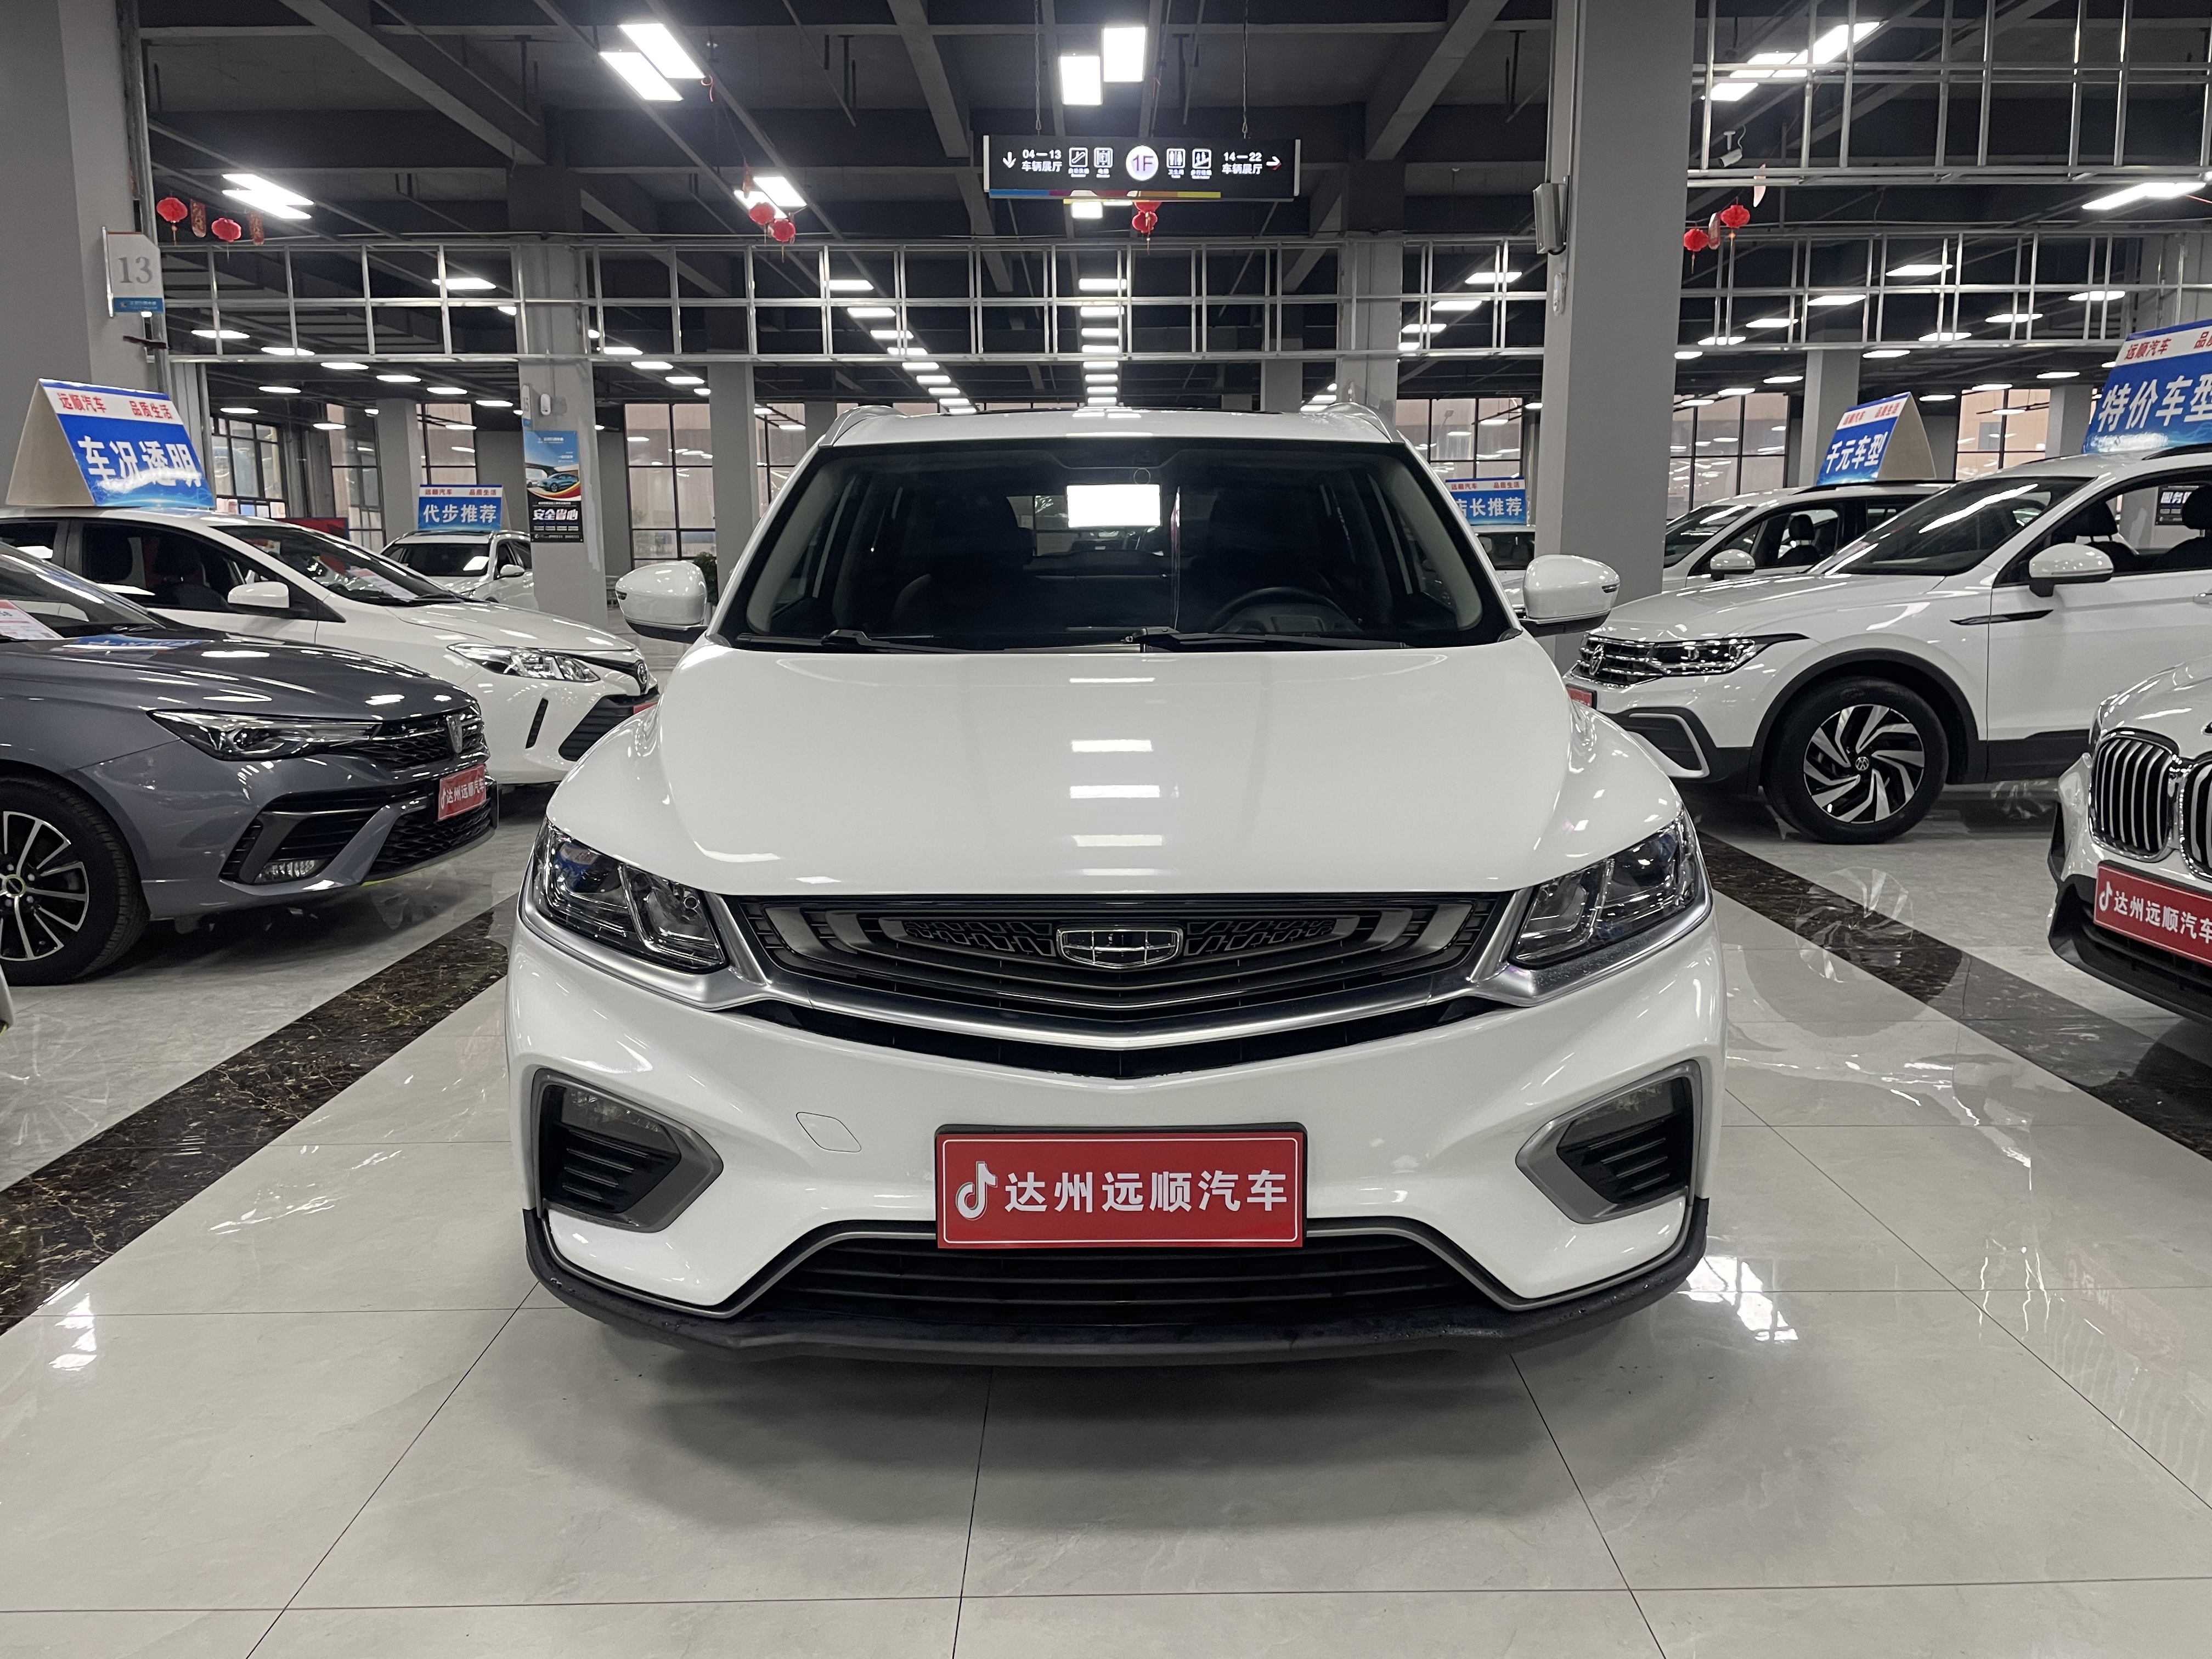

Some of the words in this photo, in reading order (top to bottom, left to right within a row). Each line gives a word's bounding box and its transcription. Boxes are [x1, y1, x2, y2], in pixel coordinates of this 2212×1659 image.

[1022, 161, 1063, 172] 车辆展厅
[1132, 155, 1154, 171] 1F
[1222, 163, 1262, 174] 车辆展厅
[119, 256, 153, 284] 13
[2124, 337, 2172, 360] 远顺汽车
[57, 392, 107, 414] 远顺汽车
[129, 400, 173, 420] 品质生活
[2097, 373, 2212, 432] 特价车型
[78, 435, 201, 487] 车况透明
[1826, 431, 1888, 474] 千元车型
[423, 504, 496, 523] 代步推荐
[446, 777, 484, 804] 达州远顺汽车
[2114, 890, 2212, 944] 达州远顺汽车
[1004, 1169, 1288, 1213] 达州远顺汽车
